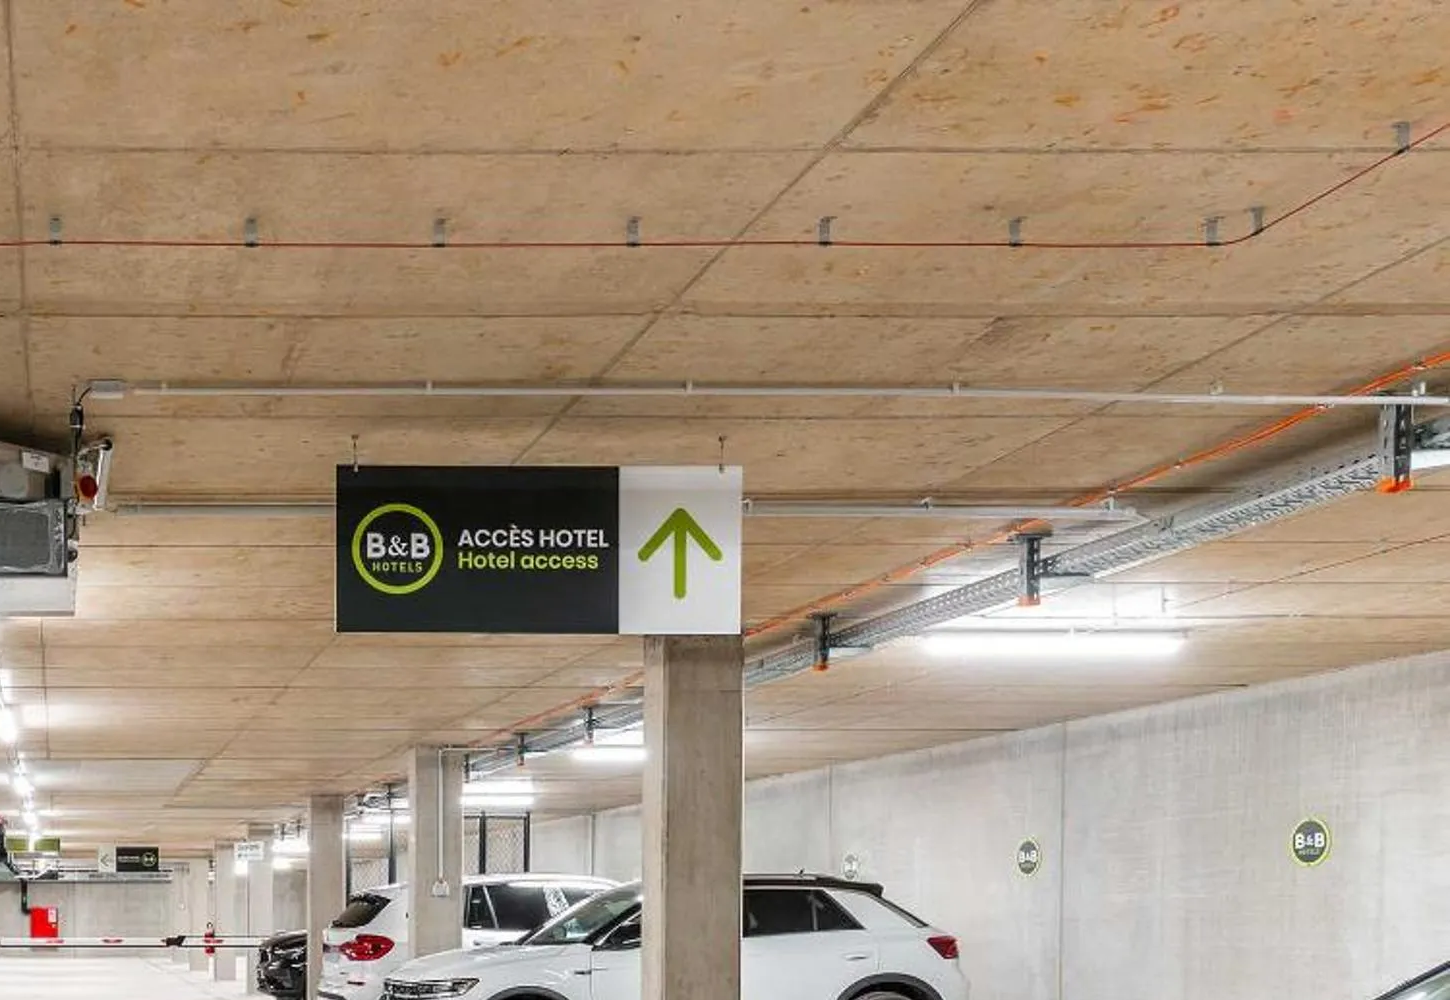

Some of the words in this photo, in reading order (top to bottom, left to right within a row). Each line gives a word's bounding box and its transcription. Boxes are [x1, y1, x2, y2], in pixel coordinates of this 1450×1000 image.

[366, 532, 430, 559] B&B
[458, 525, 535, 548] ACCÈS
[539, 529, 609, 548] HOTEL
[372, 561, 423, 573] HOTELS
[457, 551, 515, 570] Hotel
[520, 553, 599, 570] access
[1295, 833, 1325, 849] B&B
